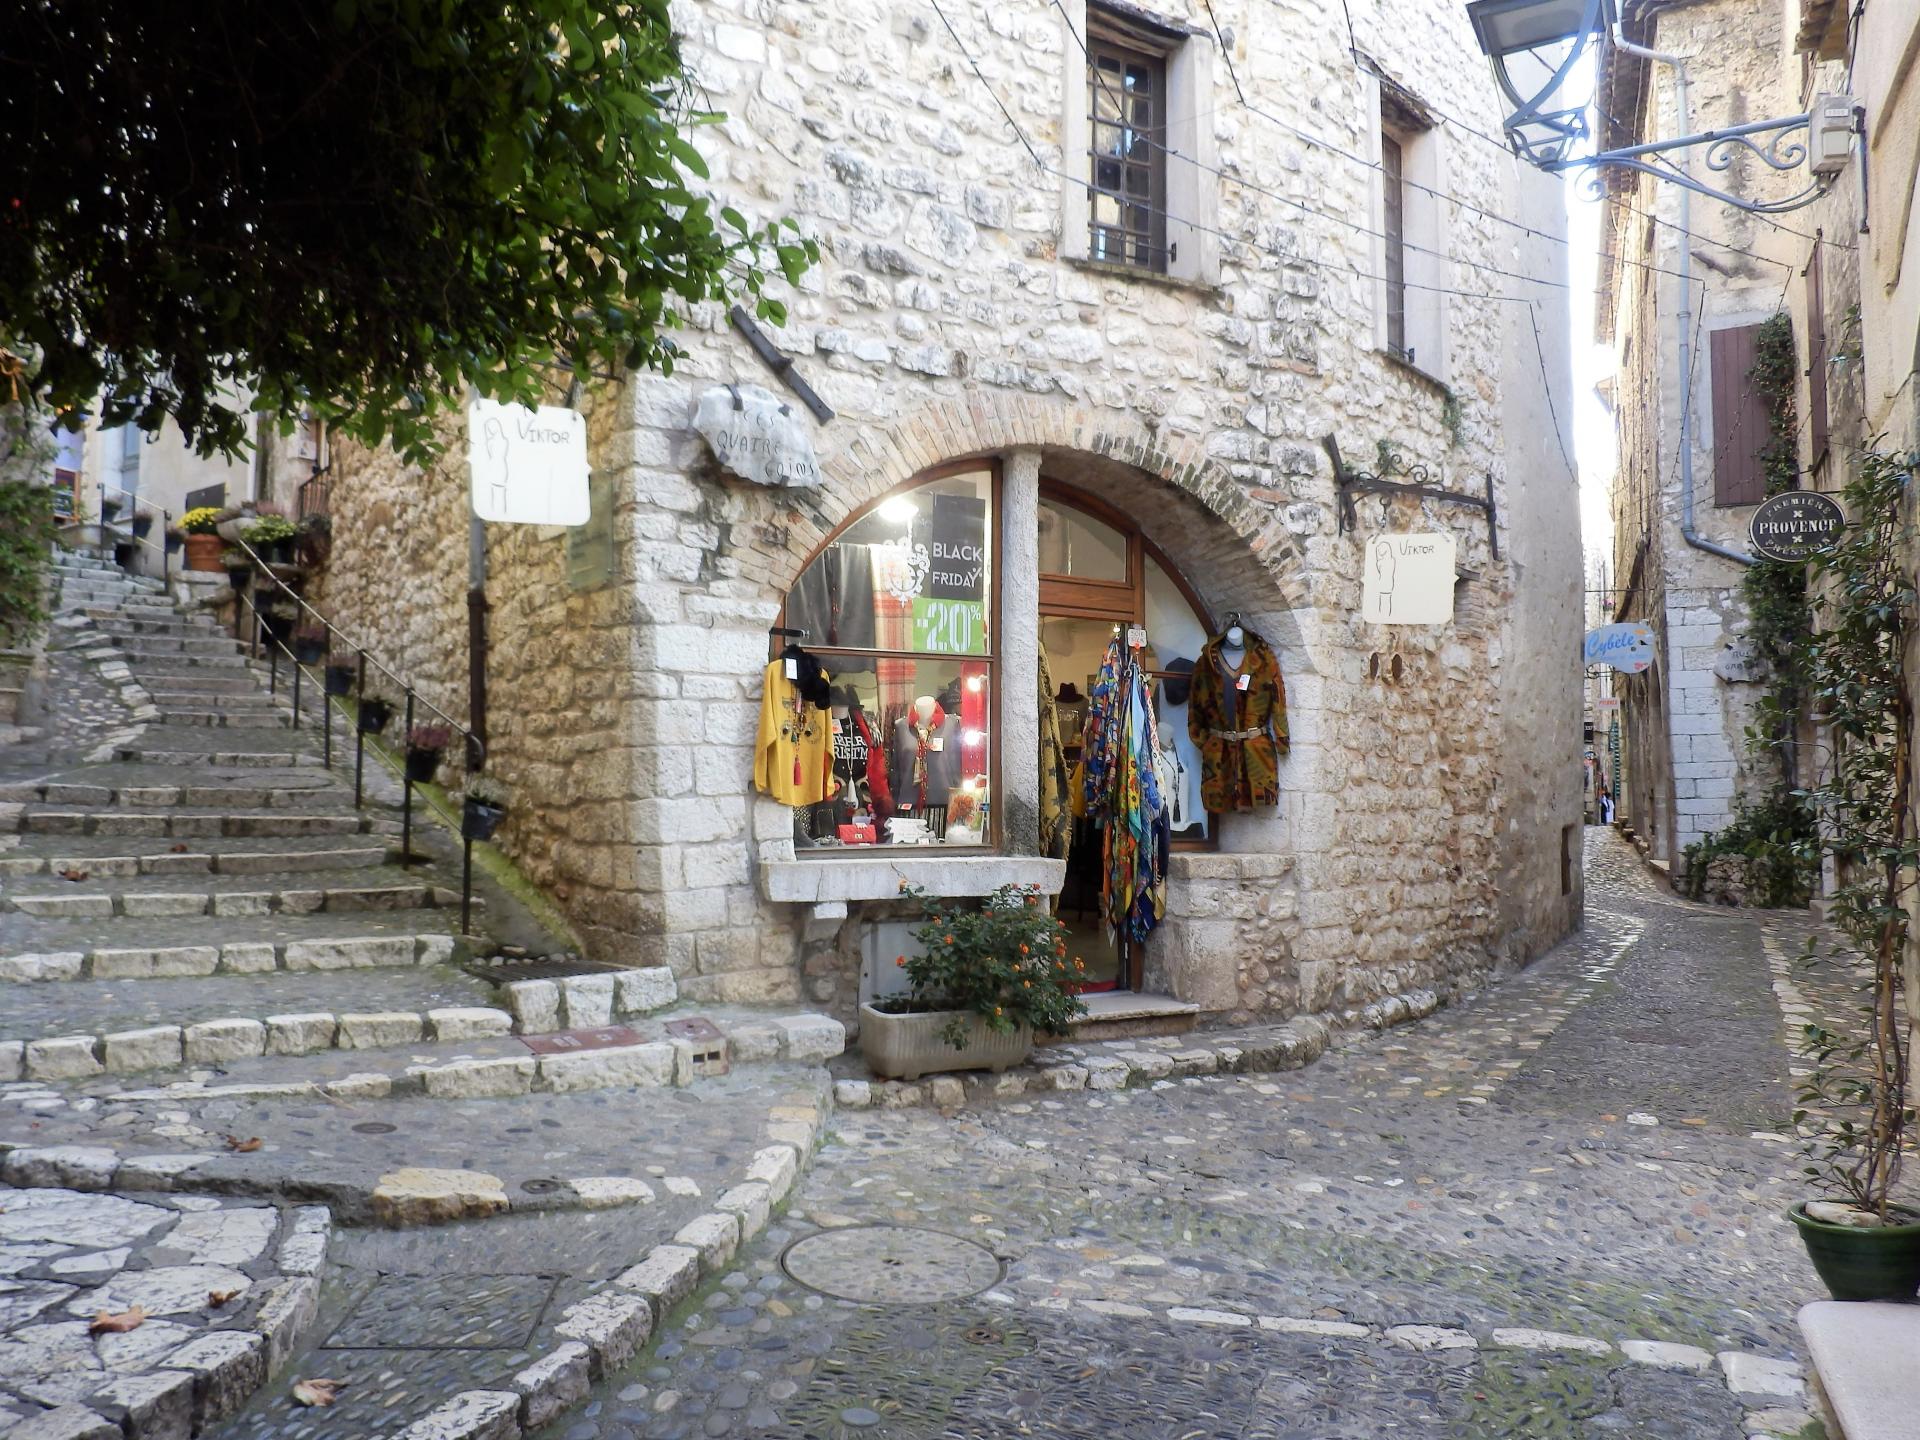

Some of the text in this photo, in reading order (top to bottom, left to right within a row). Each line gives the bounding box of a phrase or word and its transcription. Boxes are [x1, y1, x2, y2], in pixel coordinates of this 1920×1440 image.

[516, 418, 571, 444] VIKTOR
[716, 430, 784, 456] QUATRE
[1759, 519, 1837, 535] PROVENCE
[932, 542, 982, 562] BLACK
[932, 568, 982, 589] FRIDAY
[916, 602, 982, 653] -20%
